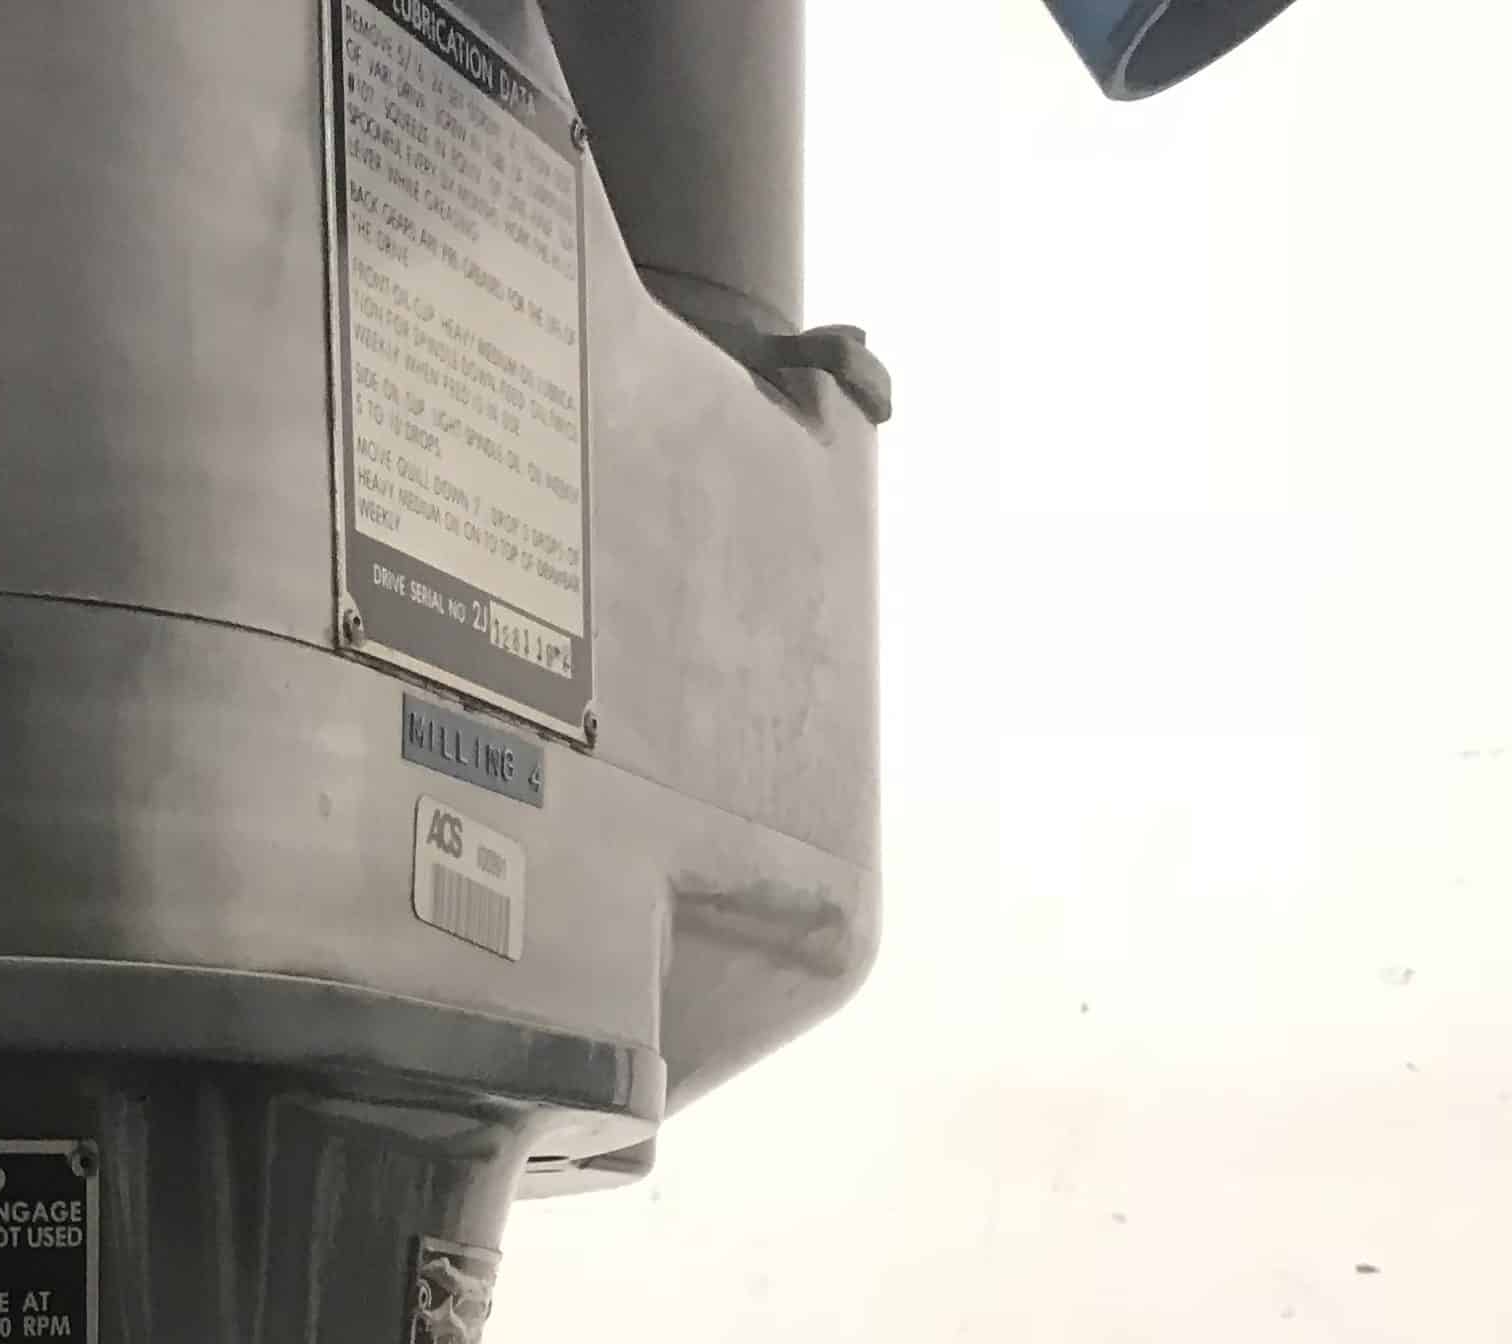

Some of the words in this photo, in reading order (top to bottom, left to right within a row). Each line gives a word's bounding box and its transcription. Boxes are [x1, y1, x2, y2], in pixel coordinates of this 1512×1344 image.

[372, 563, 406, 596] DRIVE
[409, 579, 445, 615] SERIAL
[407, 711, 515, 782] MILLING
[26, 1226, 84, 1248] USED
[21, 1290, 52, 1313] AT
[23, 1315, 72, 1337] RPM
